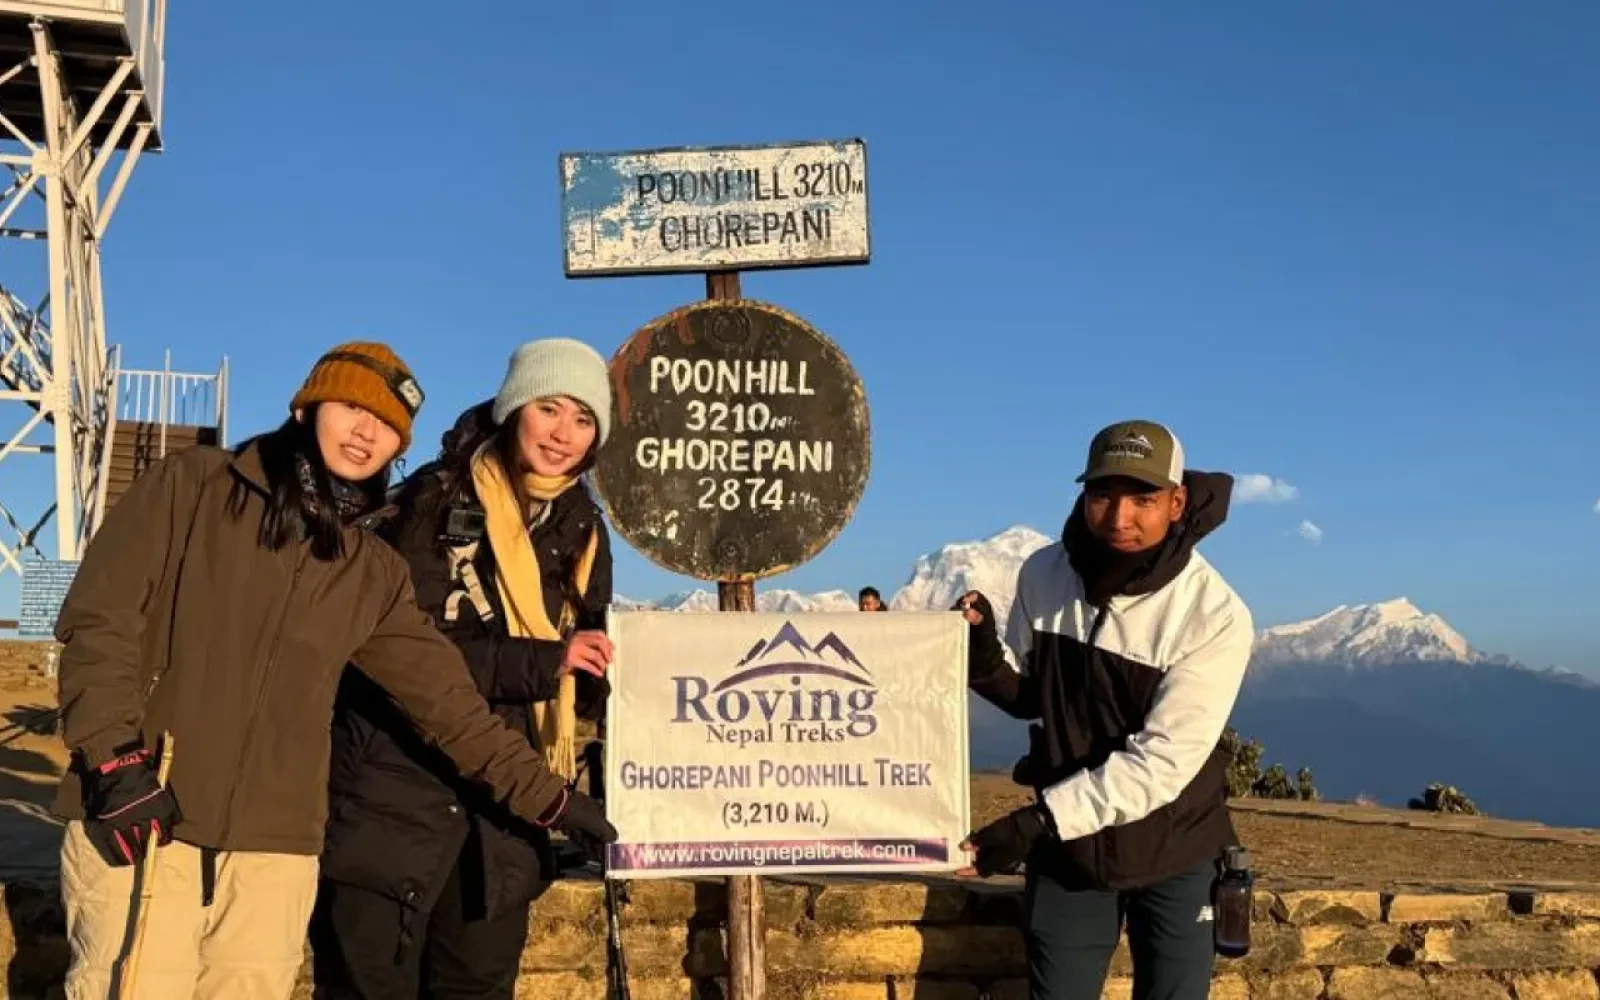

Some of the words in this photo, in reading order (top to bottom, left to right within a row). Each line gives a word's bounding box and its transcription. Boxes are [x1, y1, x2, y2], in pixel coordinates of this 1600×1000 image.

[636, 167, 790, 207] POONHILL
[650, 357, 815, 395] POONHILL
[635, 437, 833, 475] GHOREPANI
[670, 675, 878, 737] Roving
[706, 723, 774, 749] Nepal
[780, 722, 846, 744] Treks
[721, 801, 790, 829] (3,210
[794, 799, 831, 827] M.)
[643, 840, 916, 865] www.rovingnepaltrek.com
